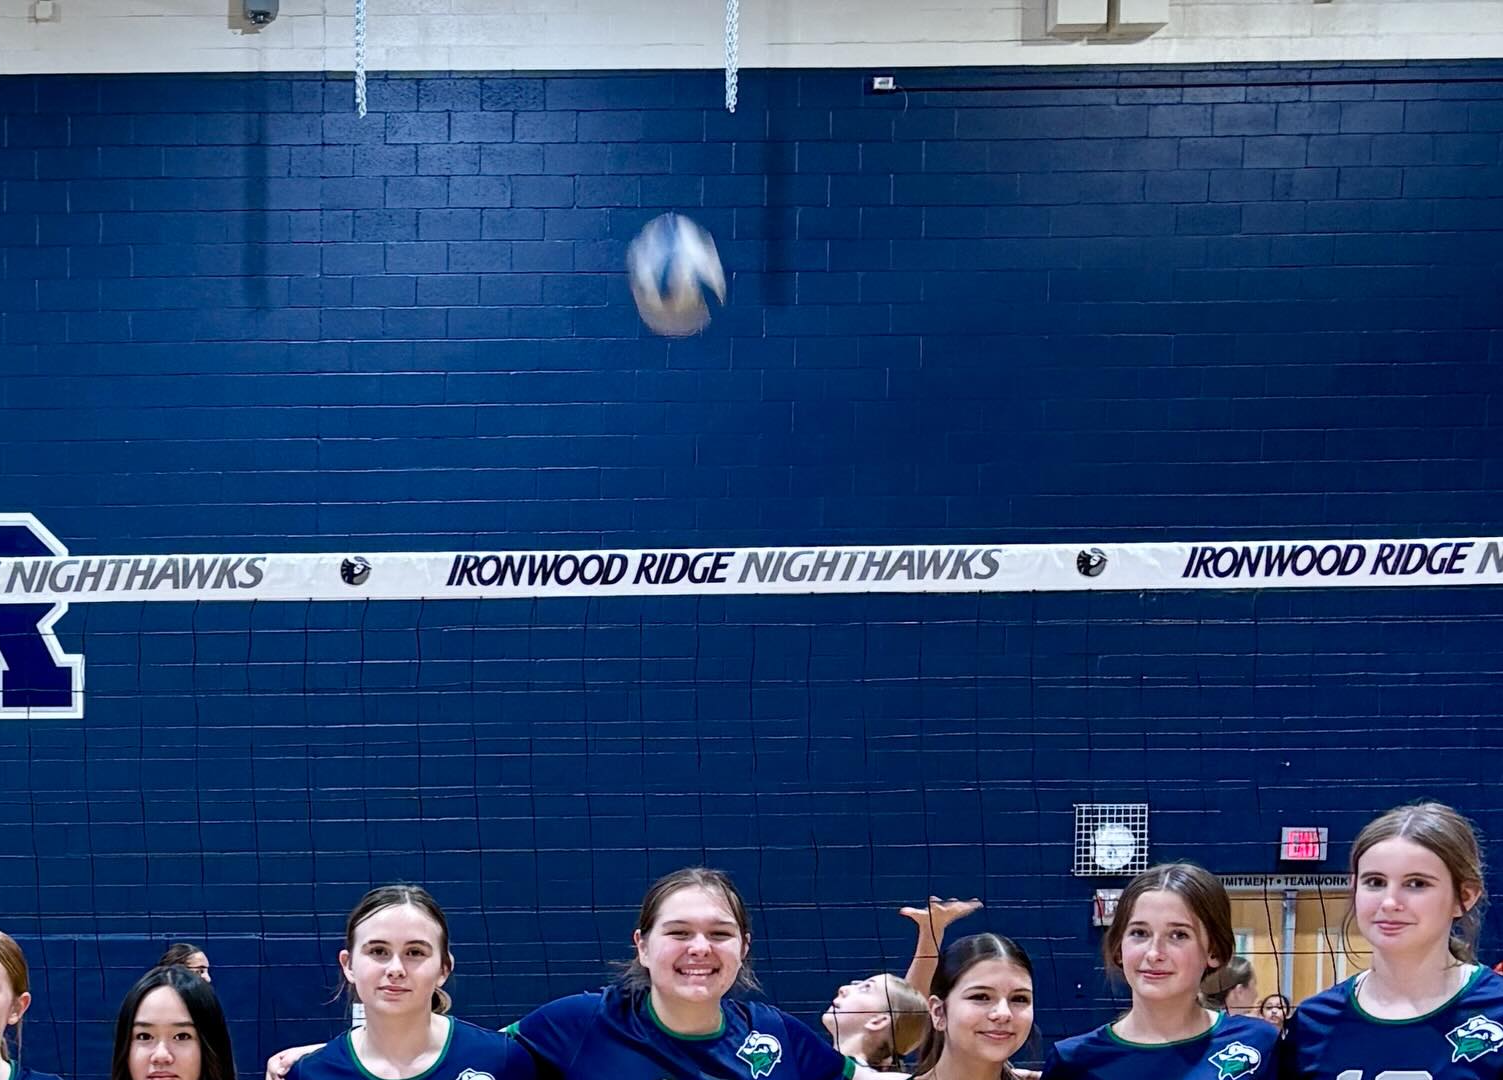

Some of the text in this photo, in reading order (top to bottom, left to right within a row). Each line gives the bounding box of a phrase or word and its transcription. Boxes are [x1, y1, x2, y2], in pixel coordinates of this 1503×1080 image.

[5, 556, 268, 593] NIGHTHAWKS
[446, 549, 1002, 586] IRONWOOD RIDGE NIGHTHAWKS
[1183, 545, 1367, 578] IRONWOOD
[1372, 541, 1475, 575] RIDGE
[1284, 875, 1348, 887] TEAMWORK
